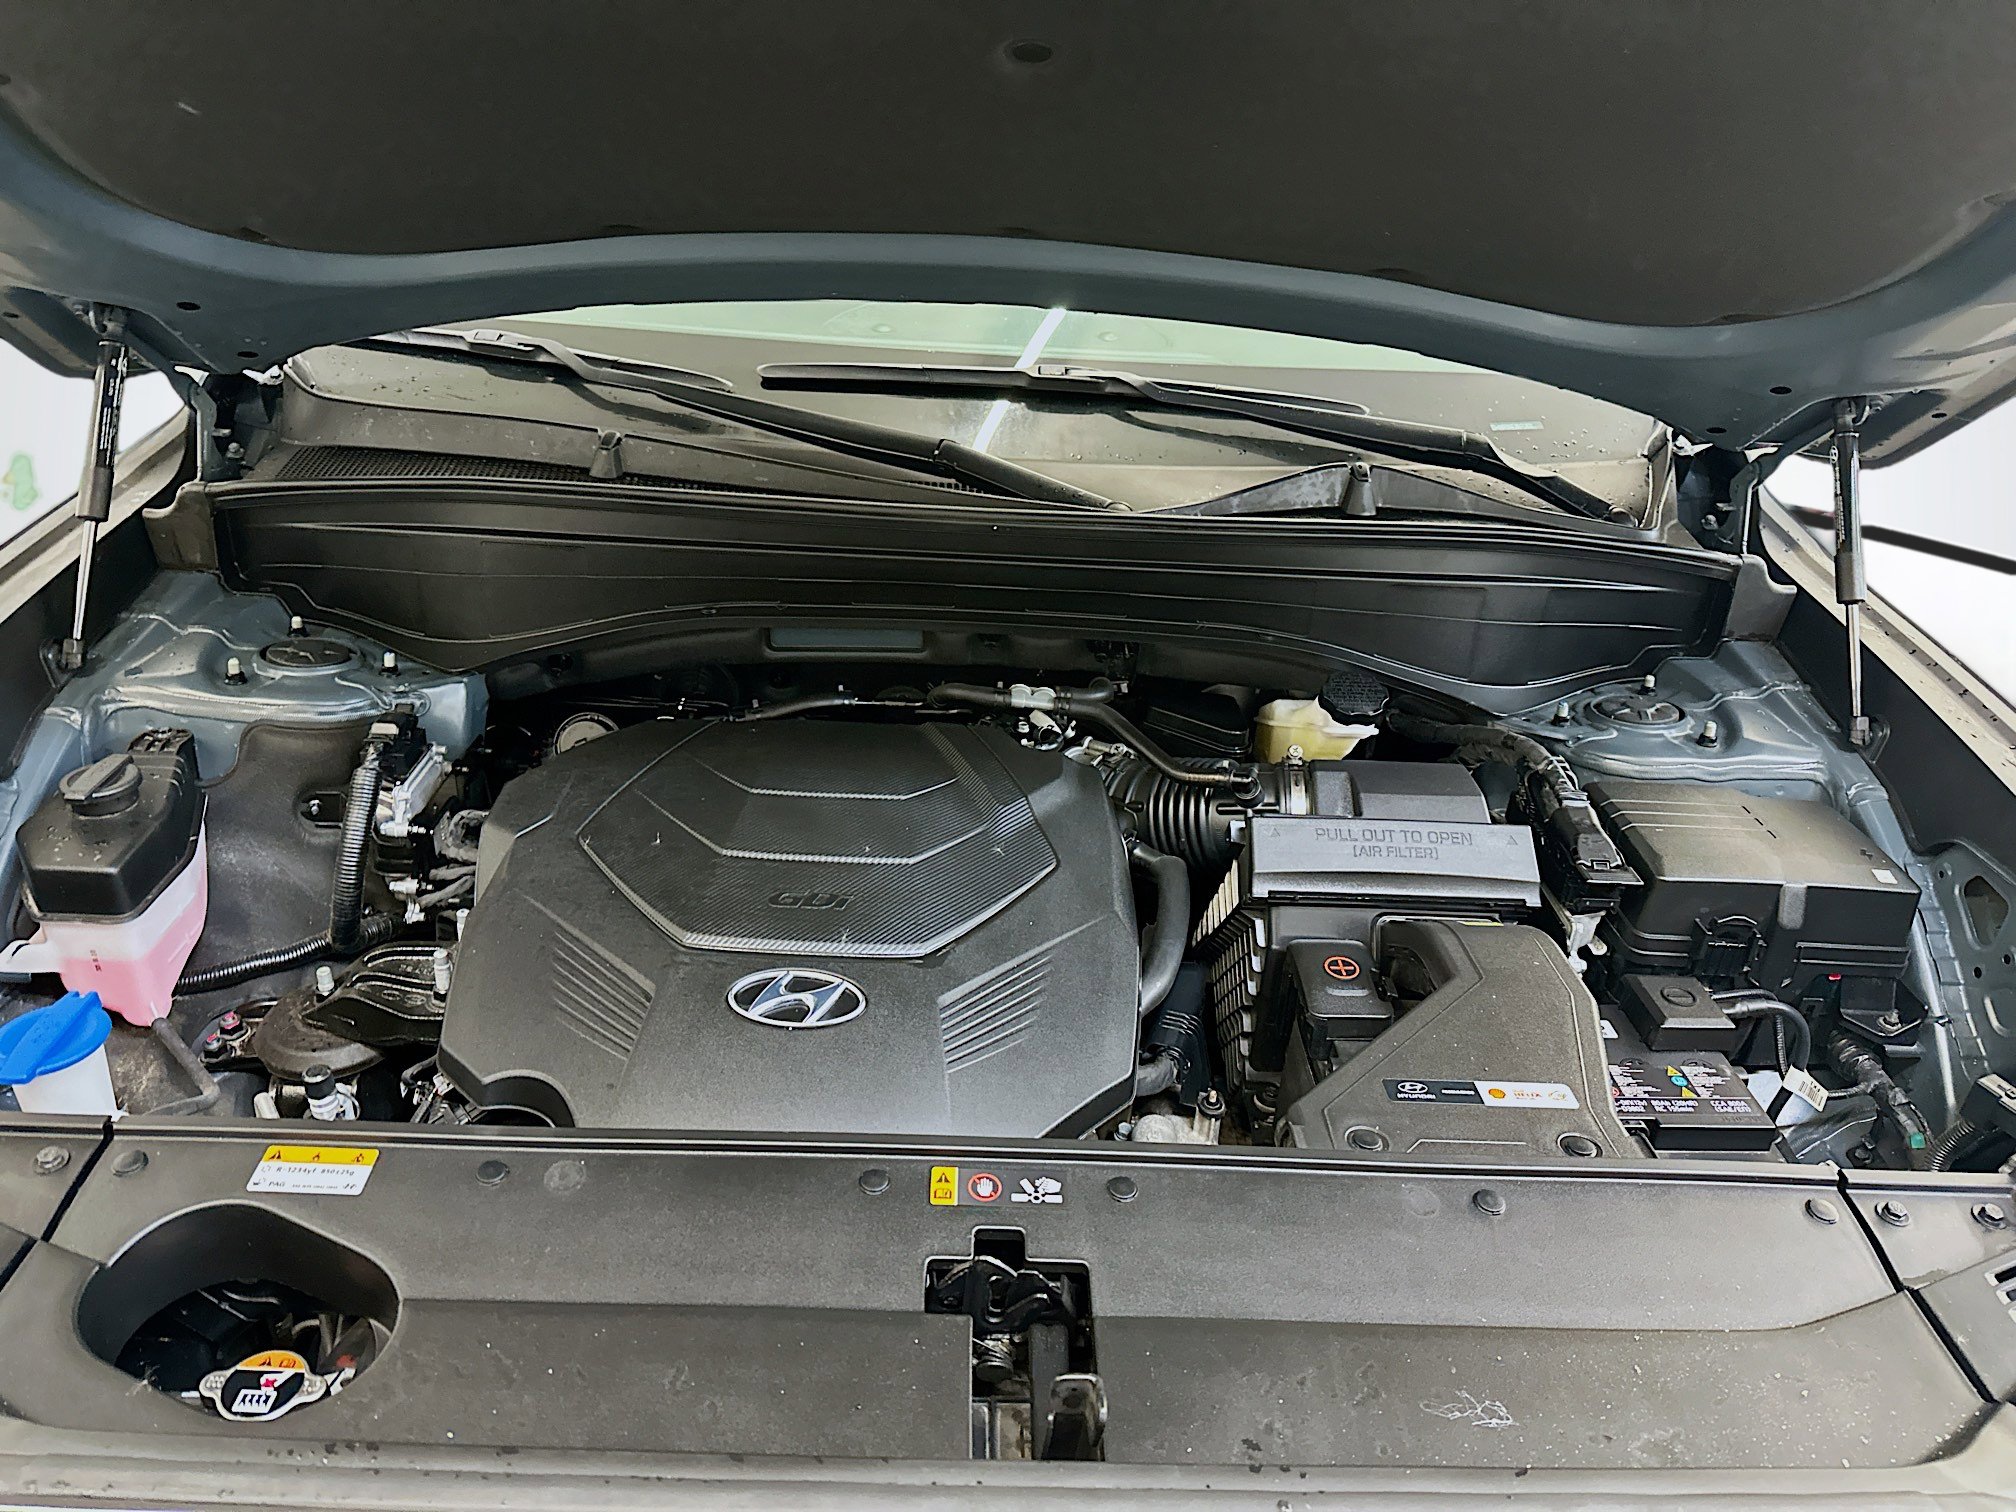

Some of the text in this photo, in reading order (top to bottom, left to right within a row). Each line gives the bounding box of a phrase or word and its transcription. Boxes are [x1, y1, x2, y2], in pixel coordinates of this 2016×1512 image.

[1315, 827, 1473, 846] PULL OUT TO OPEN
